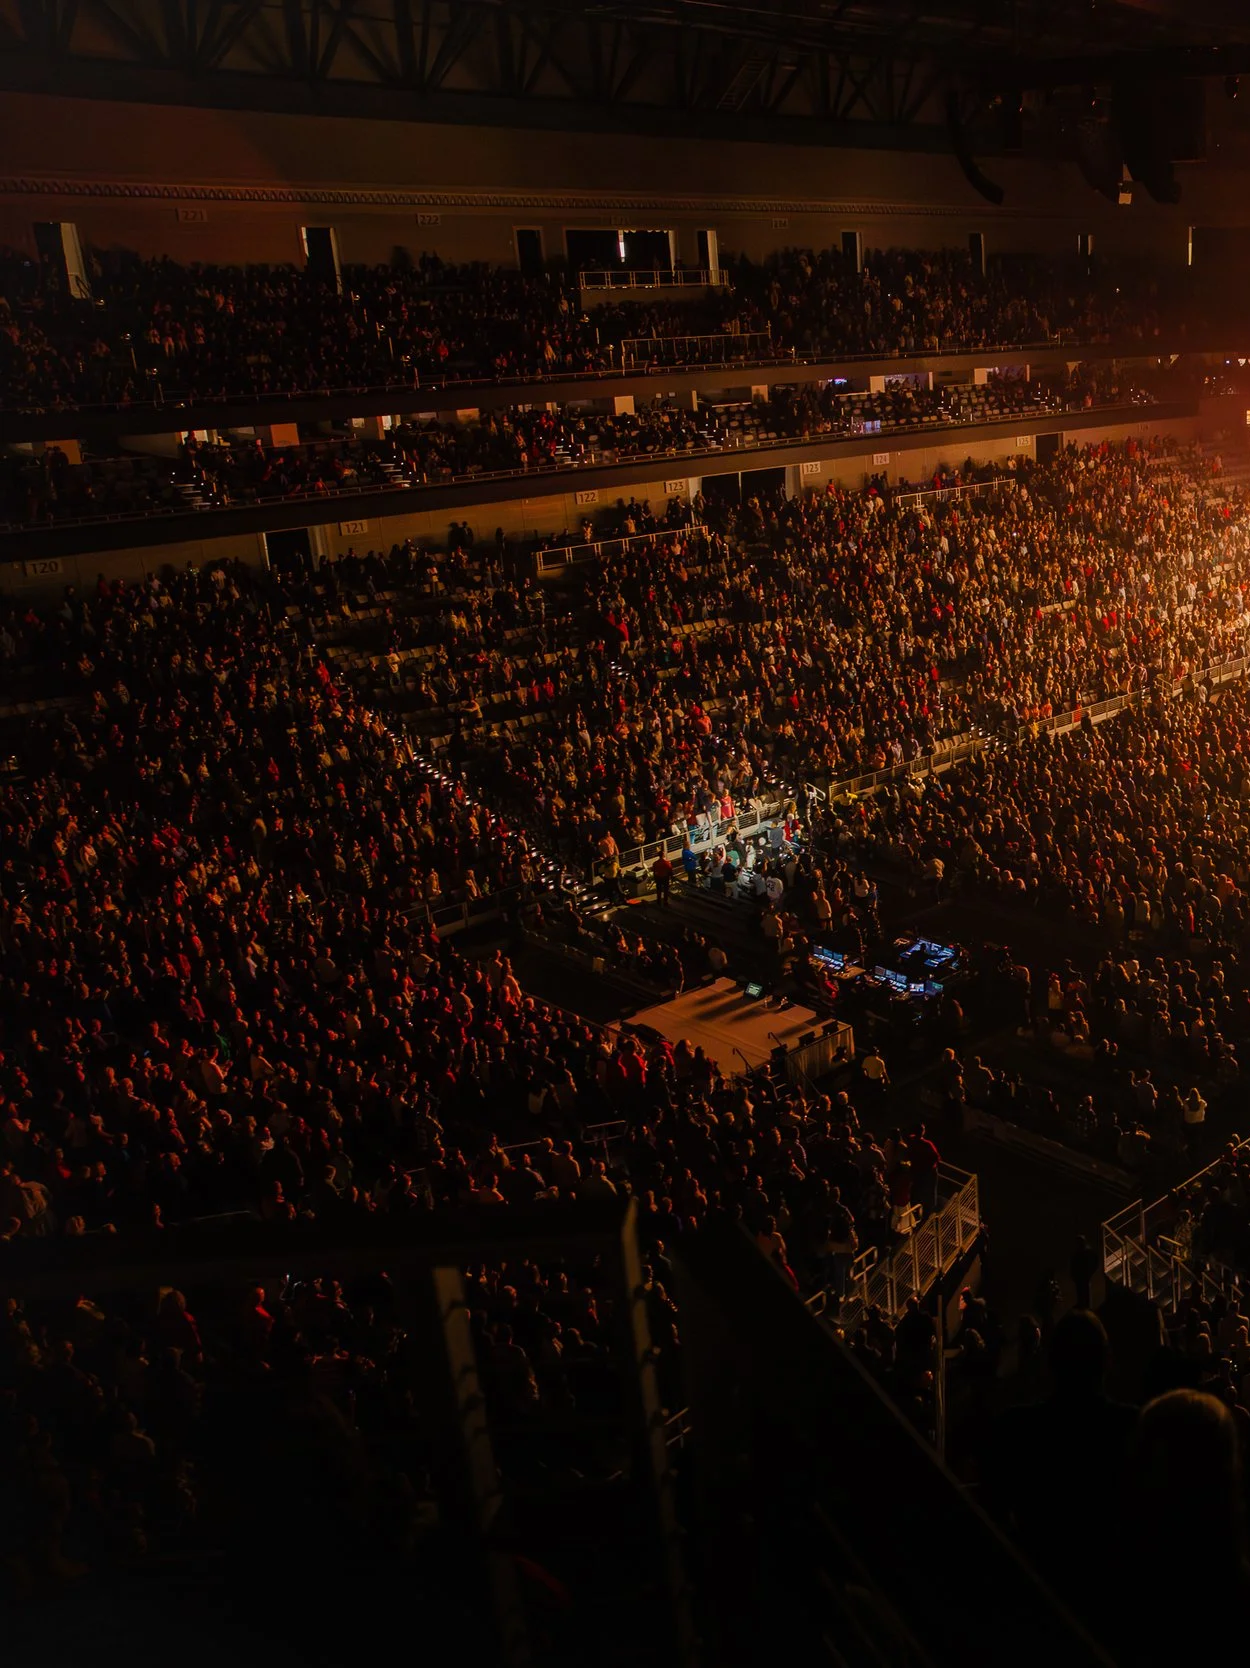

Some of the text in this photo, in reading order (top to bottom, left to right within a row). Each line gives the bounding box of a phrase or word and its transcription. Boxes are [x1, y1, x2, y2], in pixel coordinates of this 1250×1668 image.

[806, 463, 819, 473] 123
[668, 481, 684, 492] 123
[579, 492, 596, 503] 122
[345, 522, 365, 534] 121
[31, 560, 59, 575] 120
